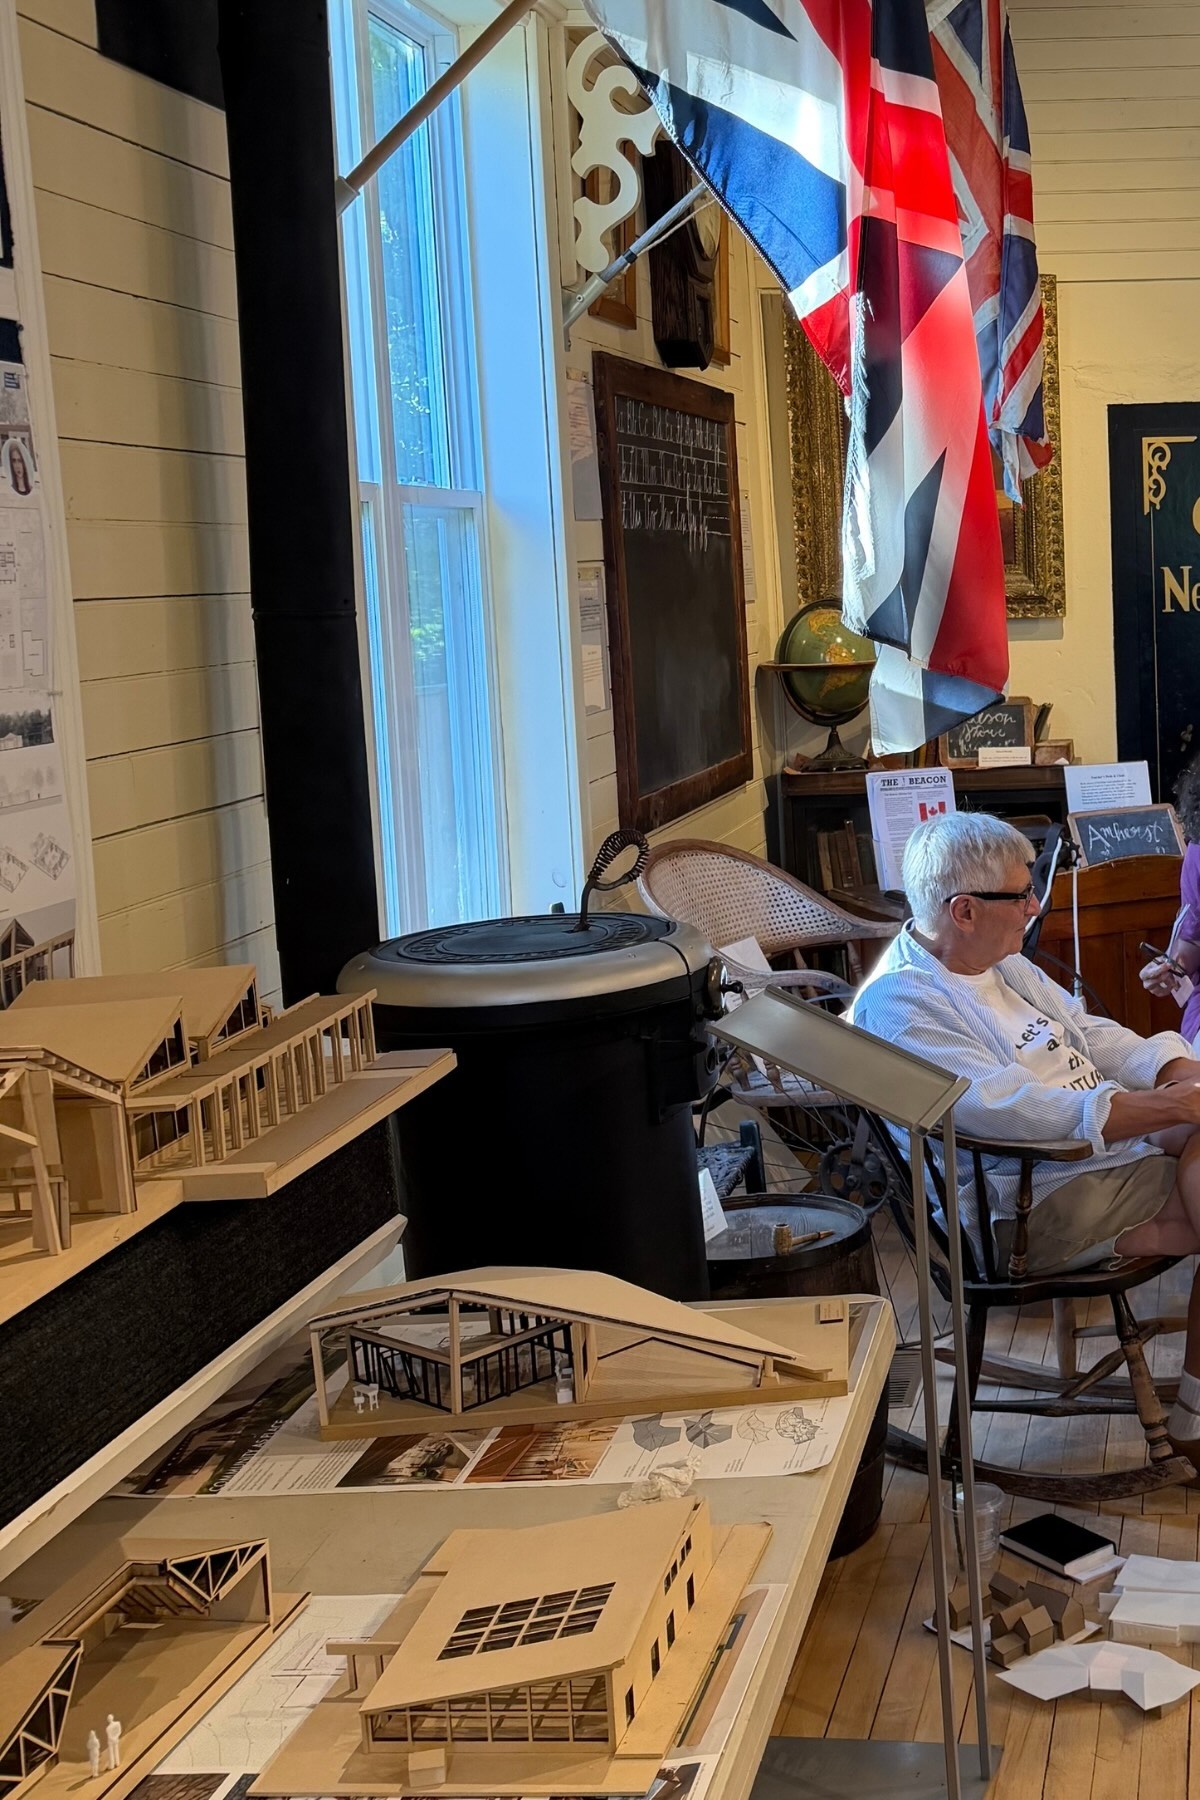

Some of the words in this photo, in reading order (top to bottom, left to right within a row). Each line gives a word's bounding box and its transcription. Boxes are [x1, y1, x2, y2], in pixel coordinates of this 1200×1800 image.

[909, 776, 946, 785] BEACON
[1089, 821, 1163, 852] Amherst
[1016, 1018, 1048, 1050] Let's
[1068, 1052, 1084, 1070] th
